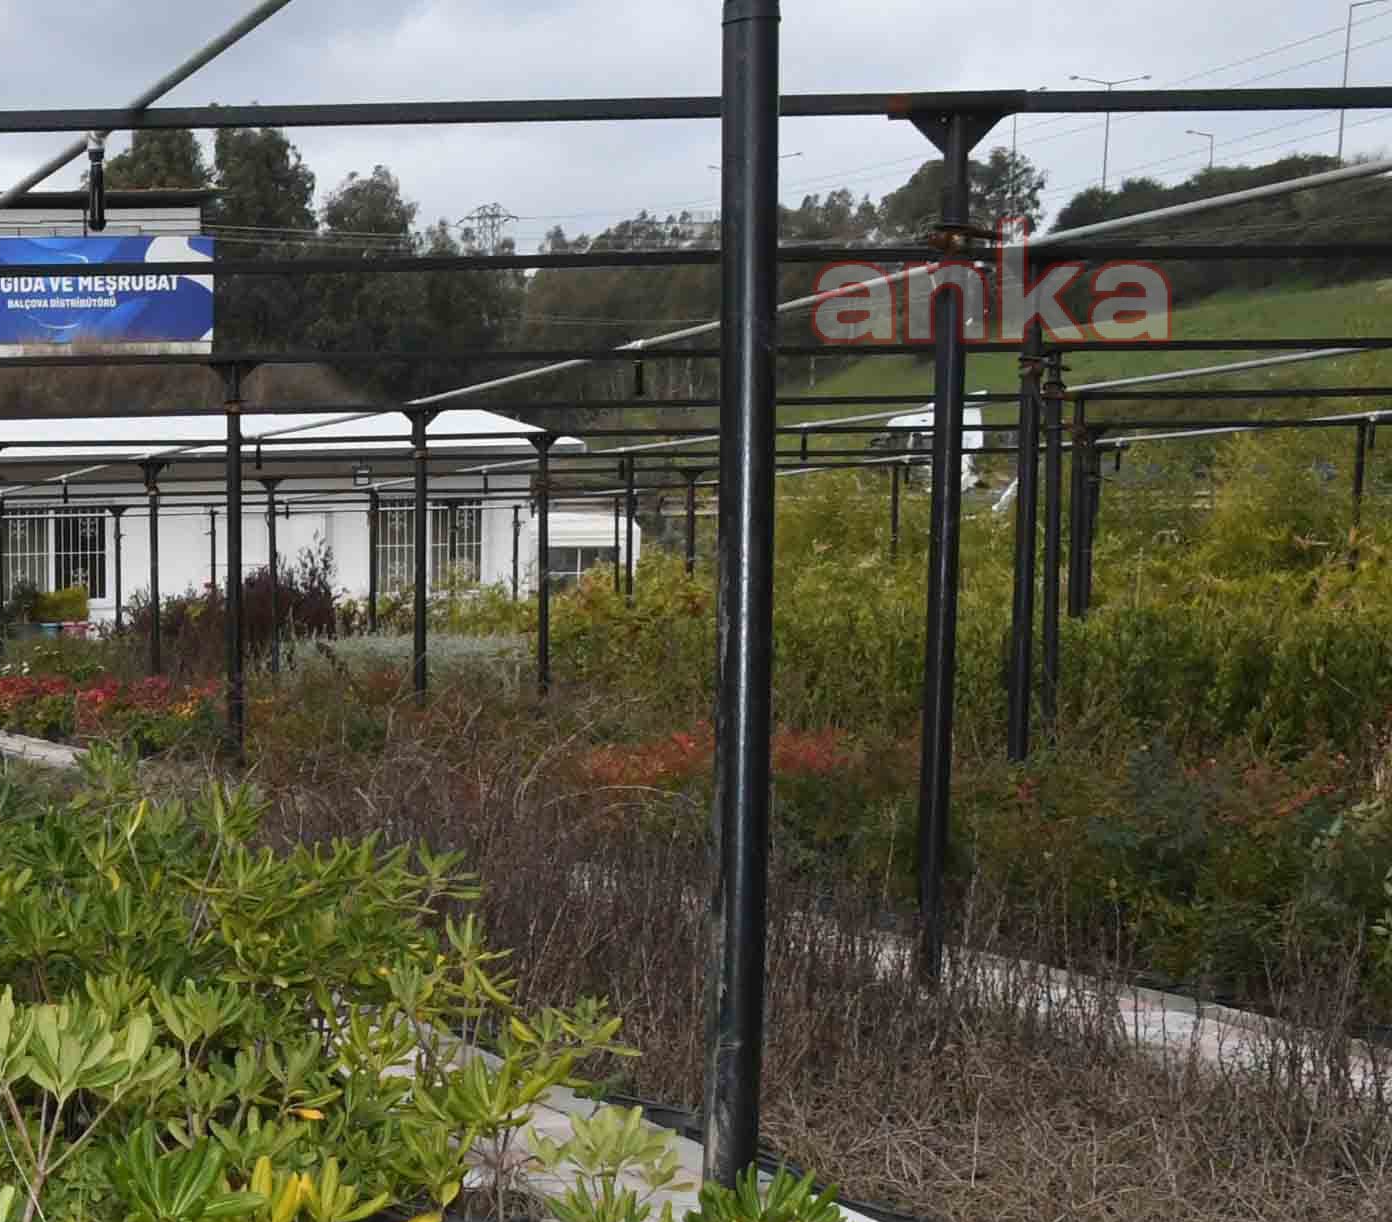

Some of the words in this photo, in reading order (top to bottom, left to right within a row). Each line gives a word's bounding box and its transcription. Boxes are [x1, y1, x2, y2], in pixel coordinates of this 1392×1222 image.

[0, 277, 45, 293] GIDA
[49, 276, 74, 292] VE
[78, 275, 178, 296] MEŞRUBAT
